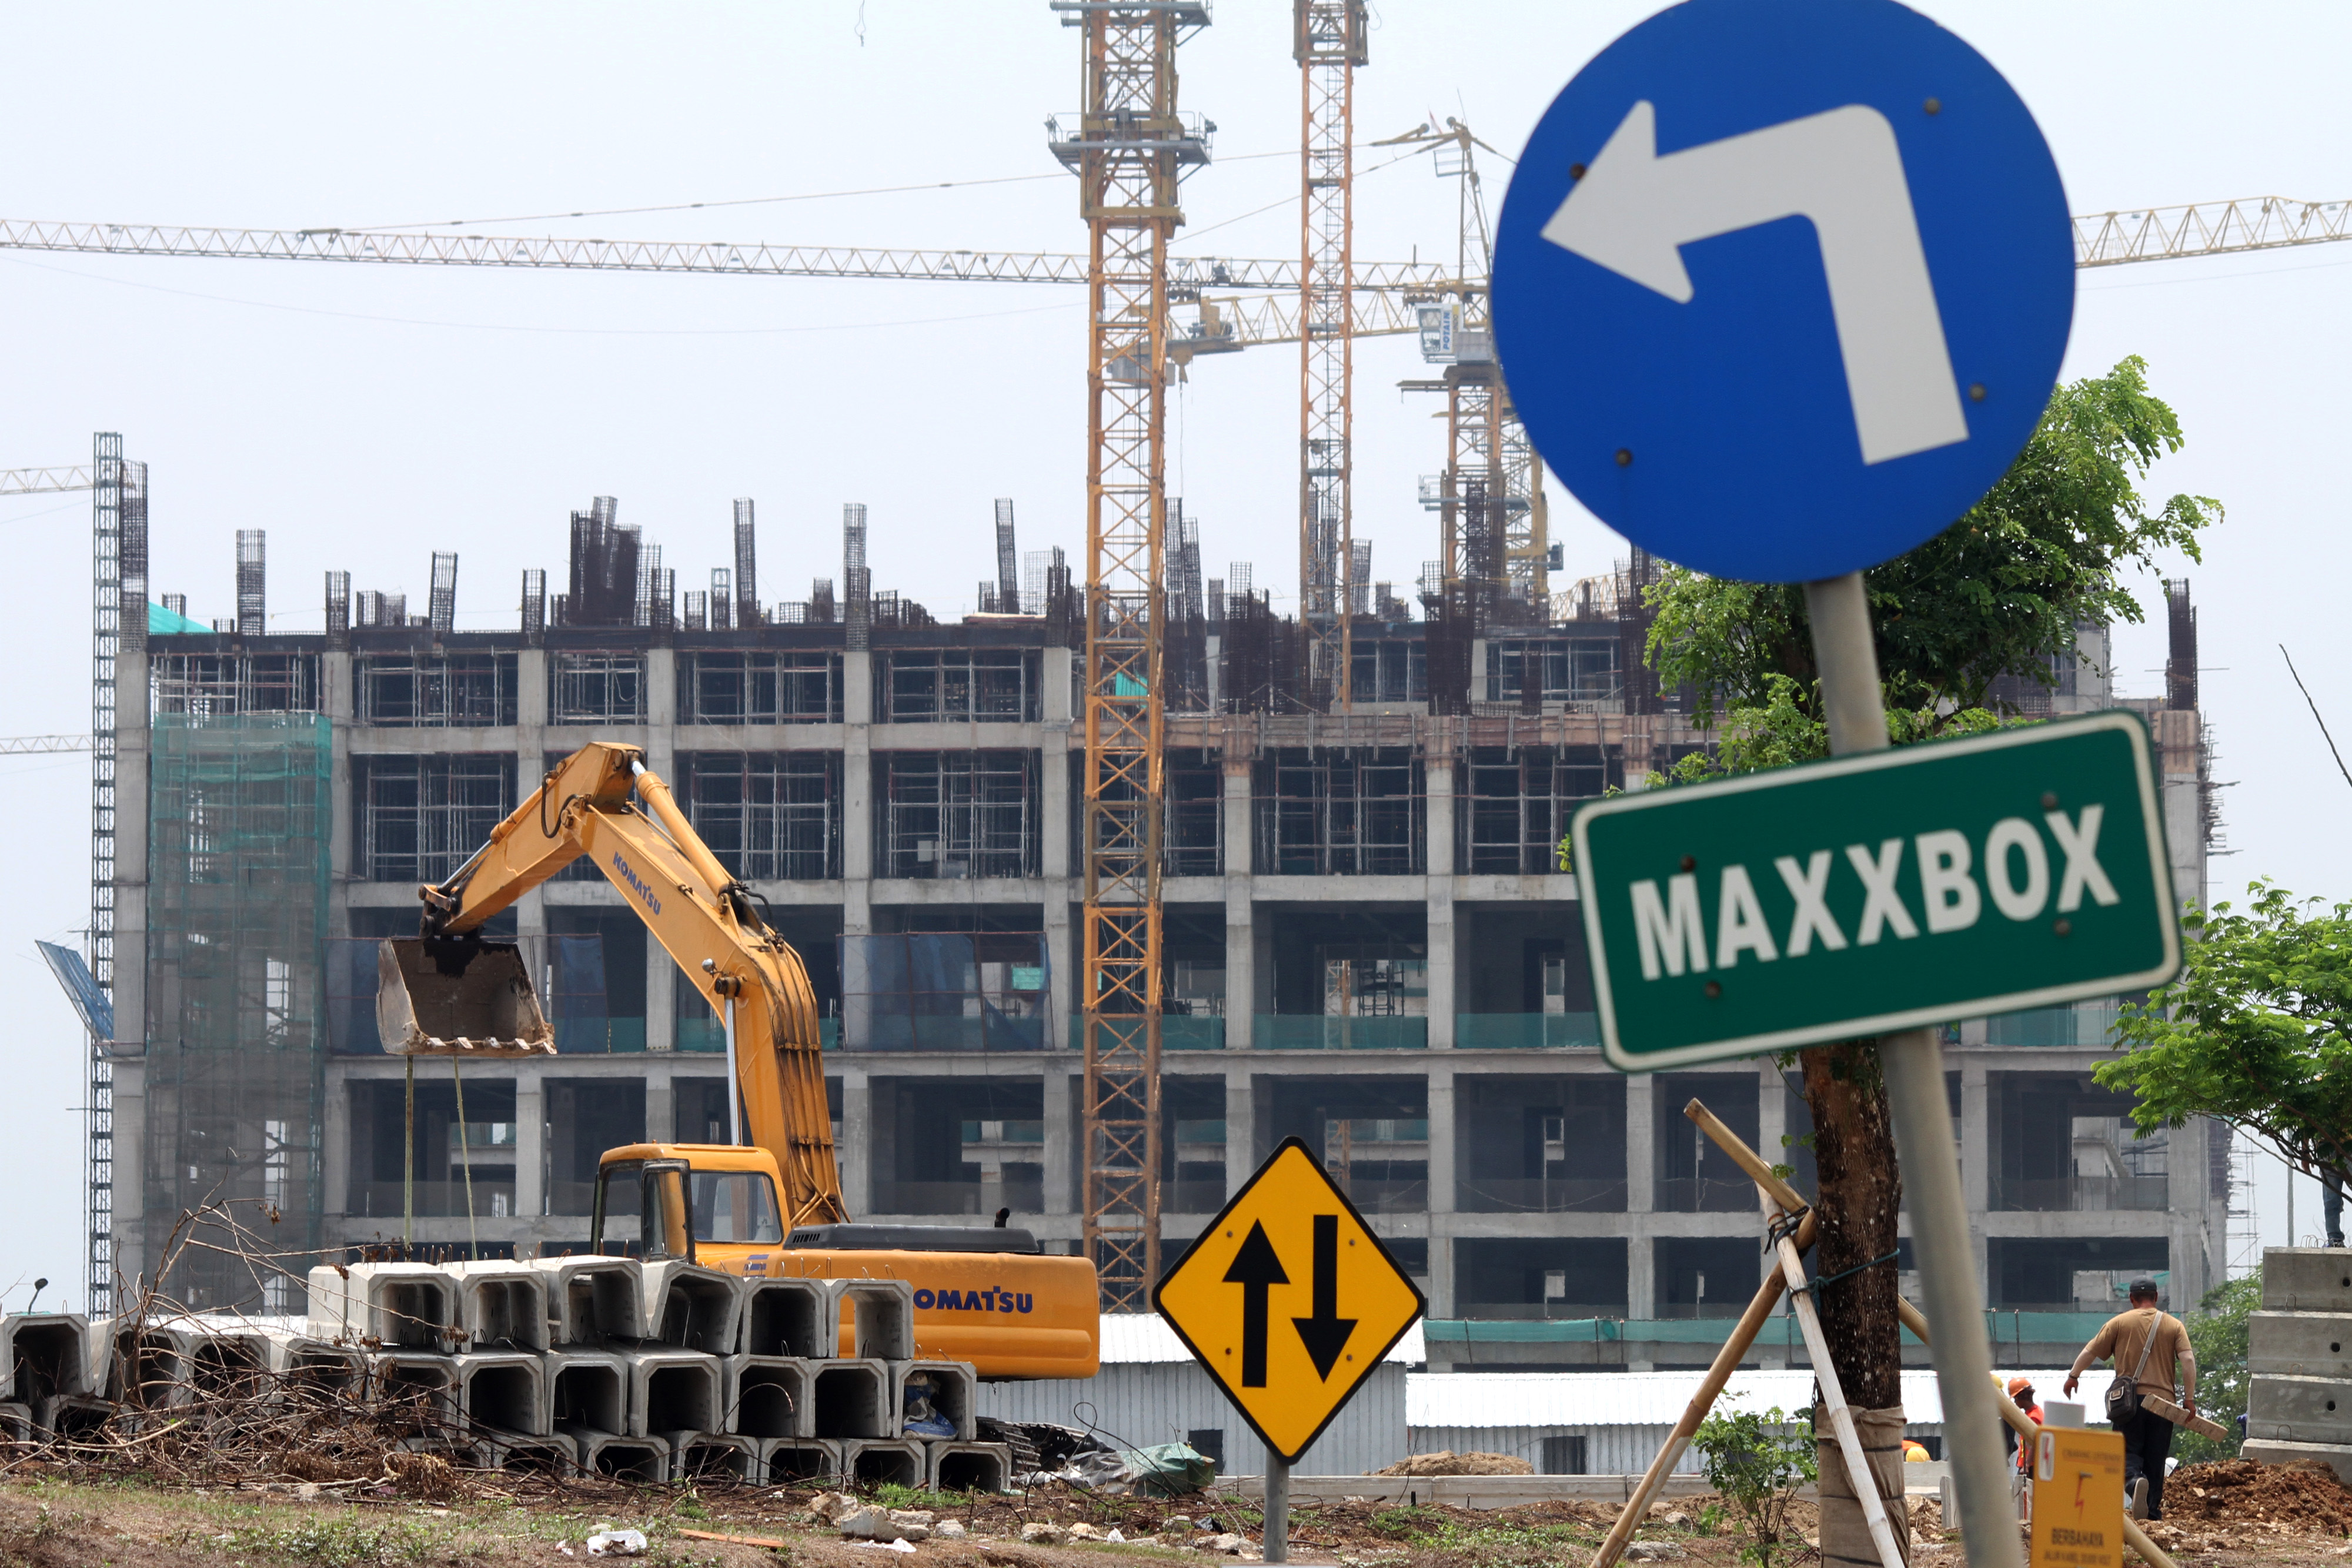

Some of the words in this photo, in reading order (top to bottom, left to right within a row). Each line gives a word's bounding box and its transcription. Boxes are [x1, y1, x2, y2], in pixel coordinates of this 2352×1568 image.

[613, 851, 662, 915] KOMATSU
[1629, 804, 2120, 981] MAXXBOX
[913, 1285, 1033, 1313] OMATSU
